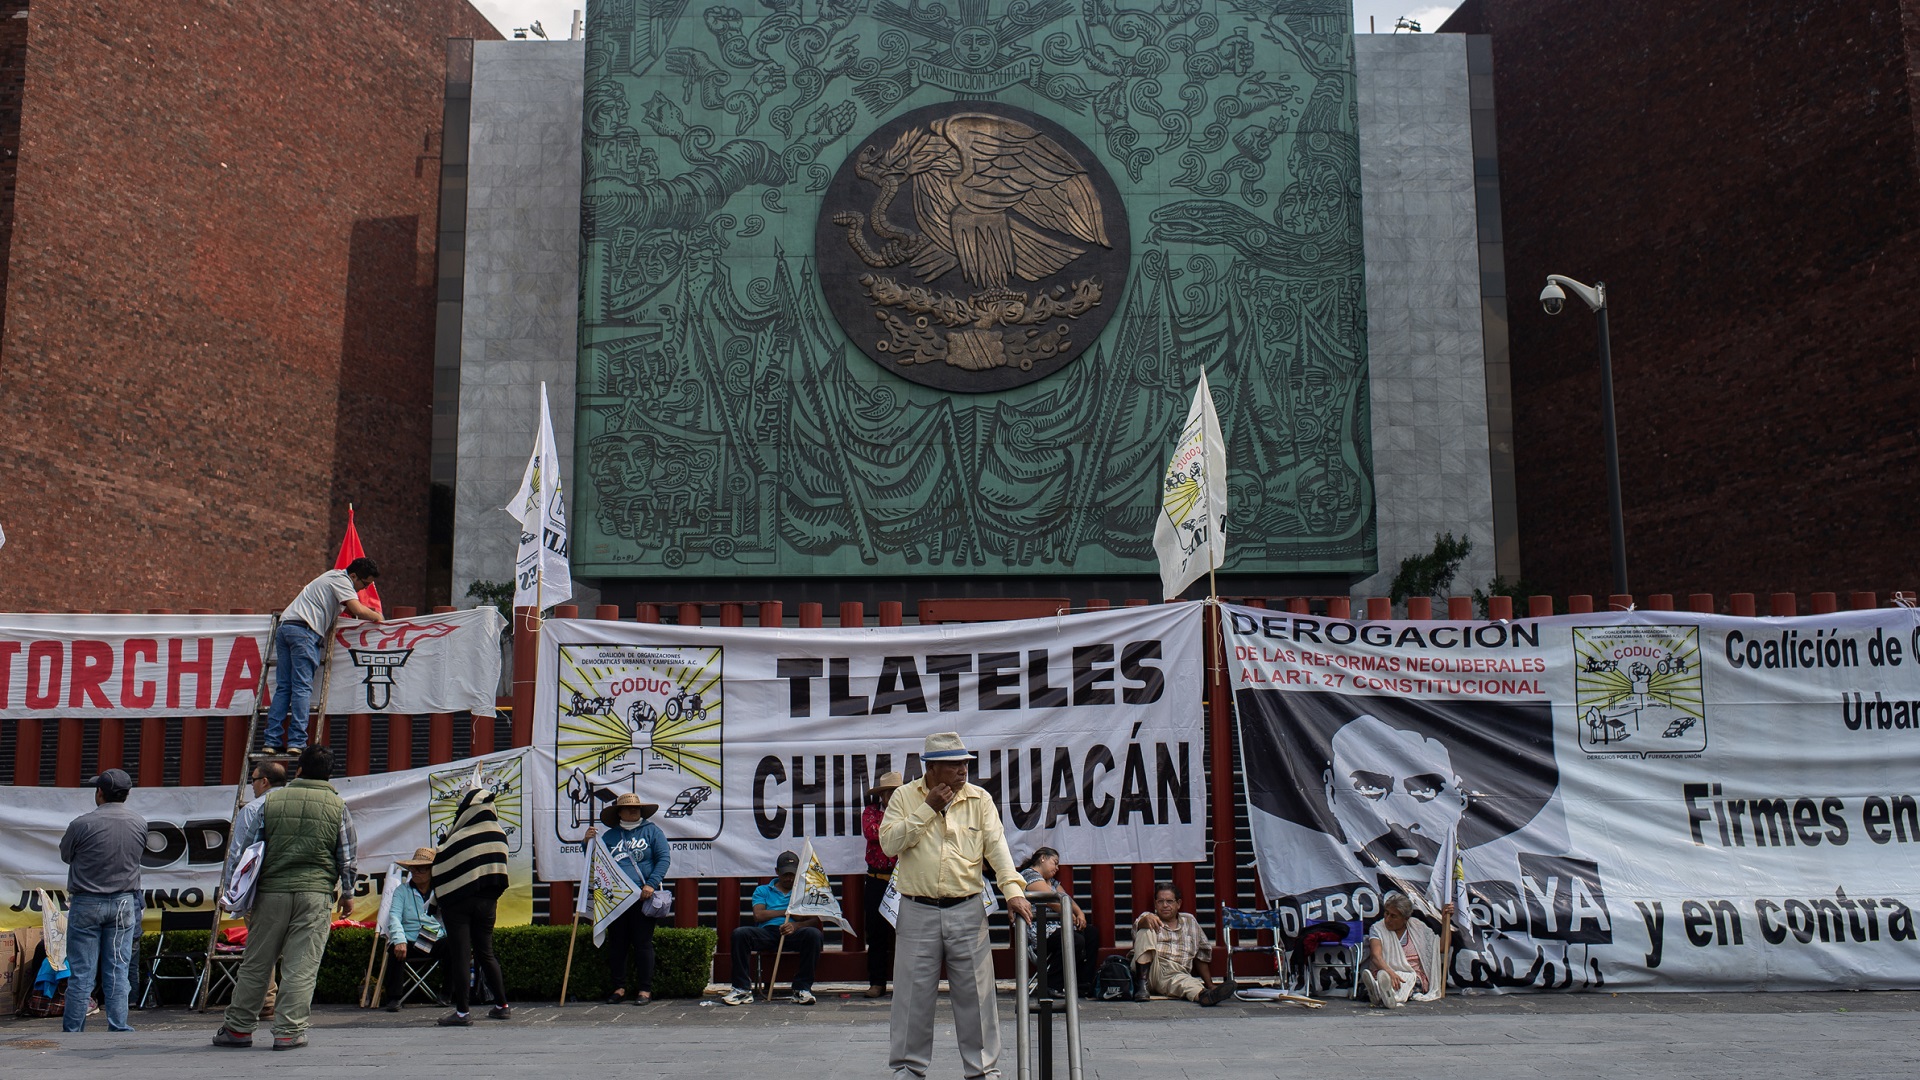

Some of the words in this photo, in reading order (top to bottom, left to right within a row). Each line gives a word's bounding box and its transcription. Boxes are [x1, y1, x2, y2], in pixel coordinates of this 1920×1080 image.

[1235, 646, 1258, 662] DE
[1263, 650, 1296, 663] LAS
[1301, 652, 1400, 672] REFORMAS
[1406, 658, 1546, 673] NEOLIBERALES
[1614, 645, 1662, 660] CODUC
[1725, 627, 1859, 669] Coalición
[1868, 628, 1902, 667] de
[610, 677, 671, 697] CODUC
[777, 640, 1165, 718] TLATELES
[1241, 668, 1267, 684] AL
[1271, 669, 1318, 686] ART.
[1324, 673, 1345, 688] 27
[1352, 676, 1546, 695] CONSTITUCIONAL
[613, 753, 626, 761] LEY
[458, 777, 494, 789] COUC
[753, 722, 1192, 840] CHIMHUACÁN
[1683, 783, 1850, 848] Firmes
[1862, 795, 1919, 844] en
[689, 842, 712, 850] UNIÓN
[1521, 876, 1612, 932] YA
[1635, 901, 1664, 969] y
[1681, 900, 1745, 947] en
[1754, 885, 1917, 945] contra
